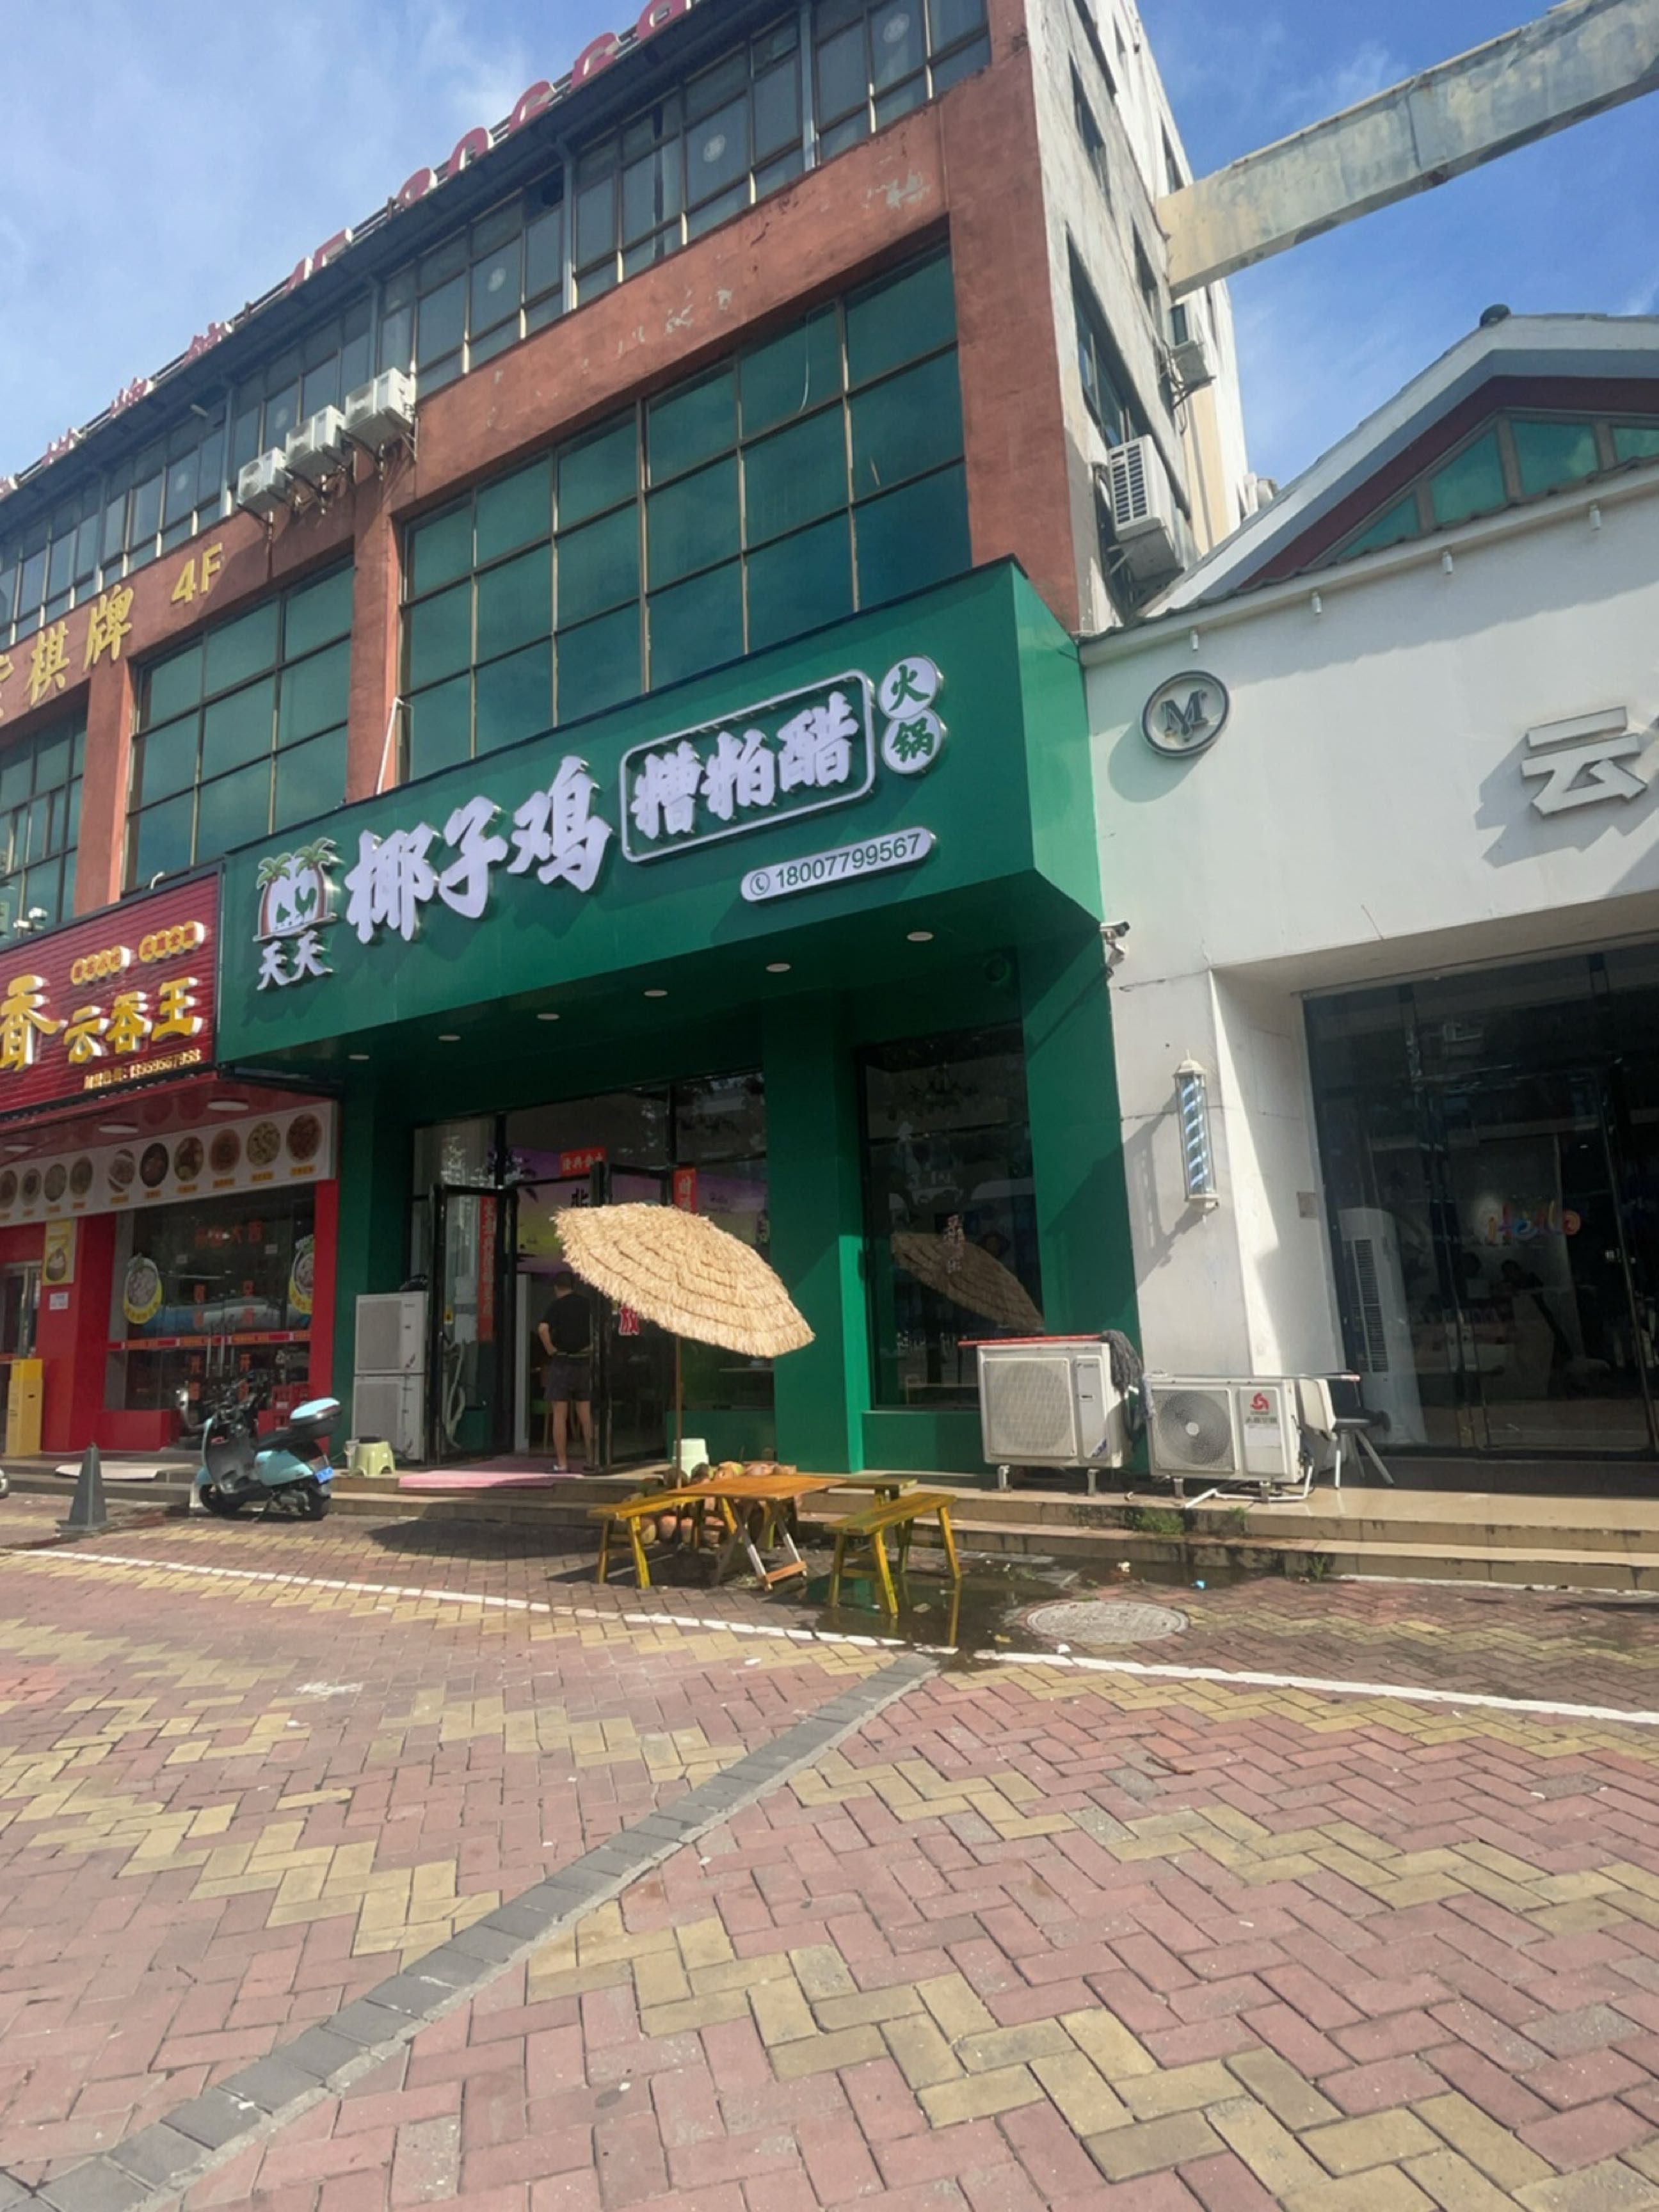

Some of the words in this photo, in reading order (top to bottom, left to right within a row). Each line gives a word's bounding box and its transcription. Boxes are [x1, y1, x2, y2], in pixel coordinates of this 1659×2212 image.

[0, 584, 133, 718] 棋牌
[171, 542, 224, 603] 4F
[888, 664, 935, 764] 火锅
[1160, 689, 1208, 742] M
[1521, 706, 1647, 817] 云
[344, 755, 613, 944] 椰子鸡
[630, 691, 860, 840] 糟粕醋
[775, 833, 921, 889] 18007799567
[257, 930, 326, 991] 天天
[0, 974, 67, 1072] 香
[64, 976, 204, 1064] 云吞王
